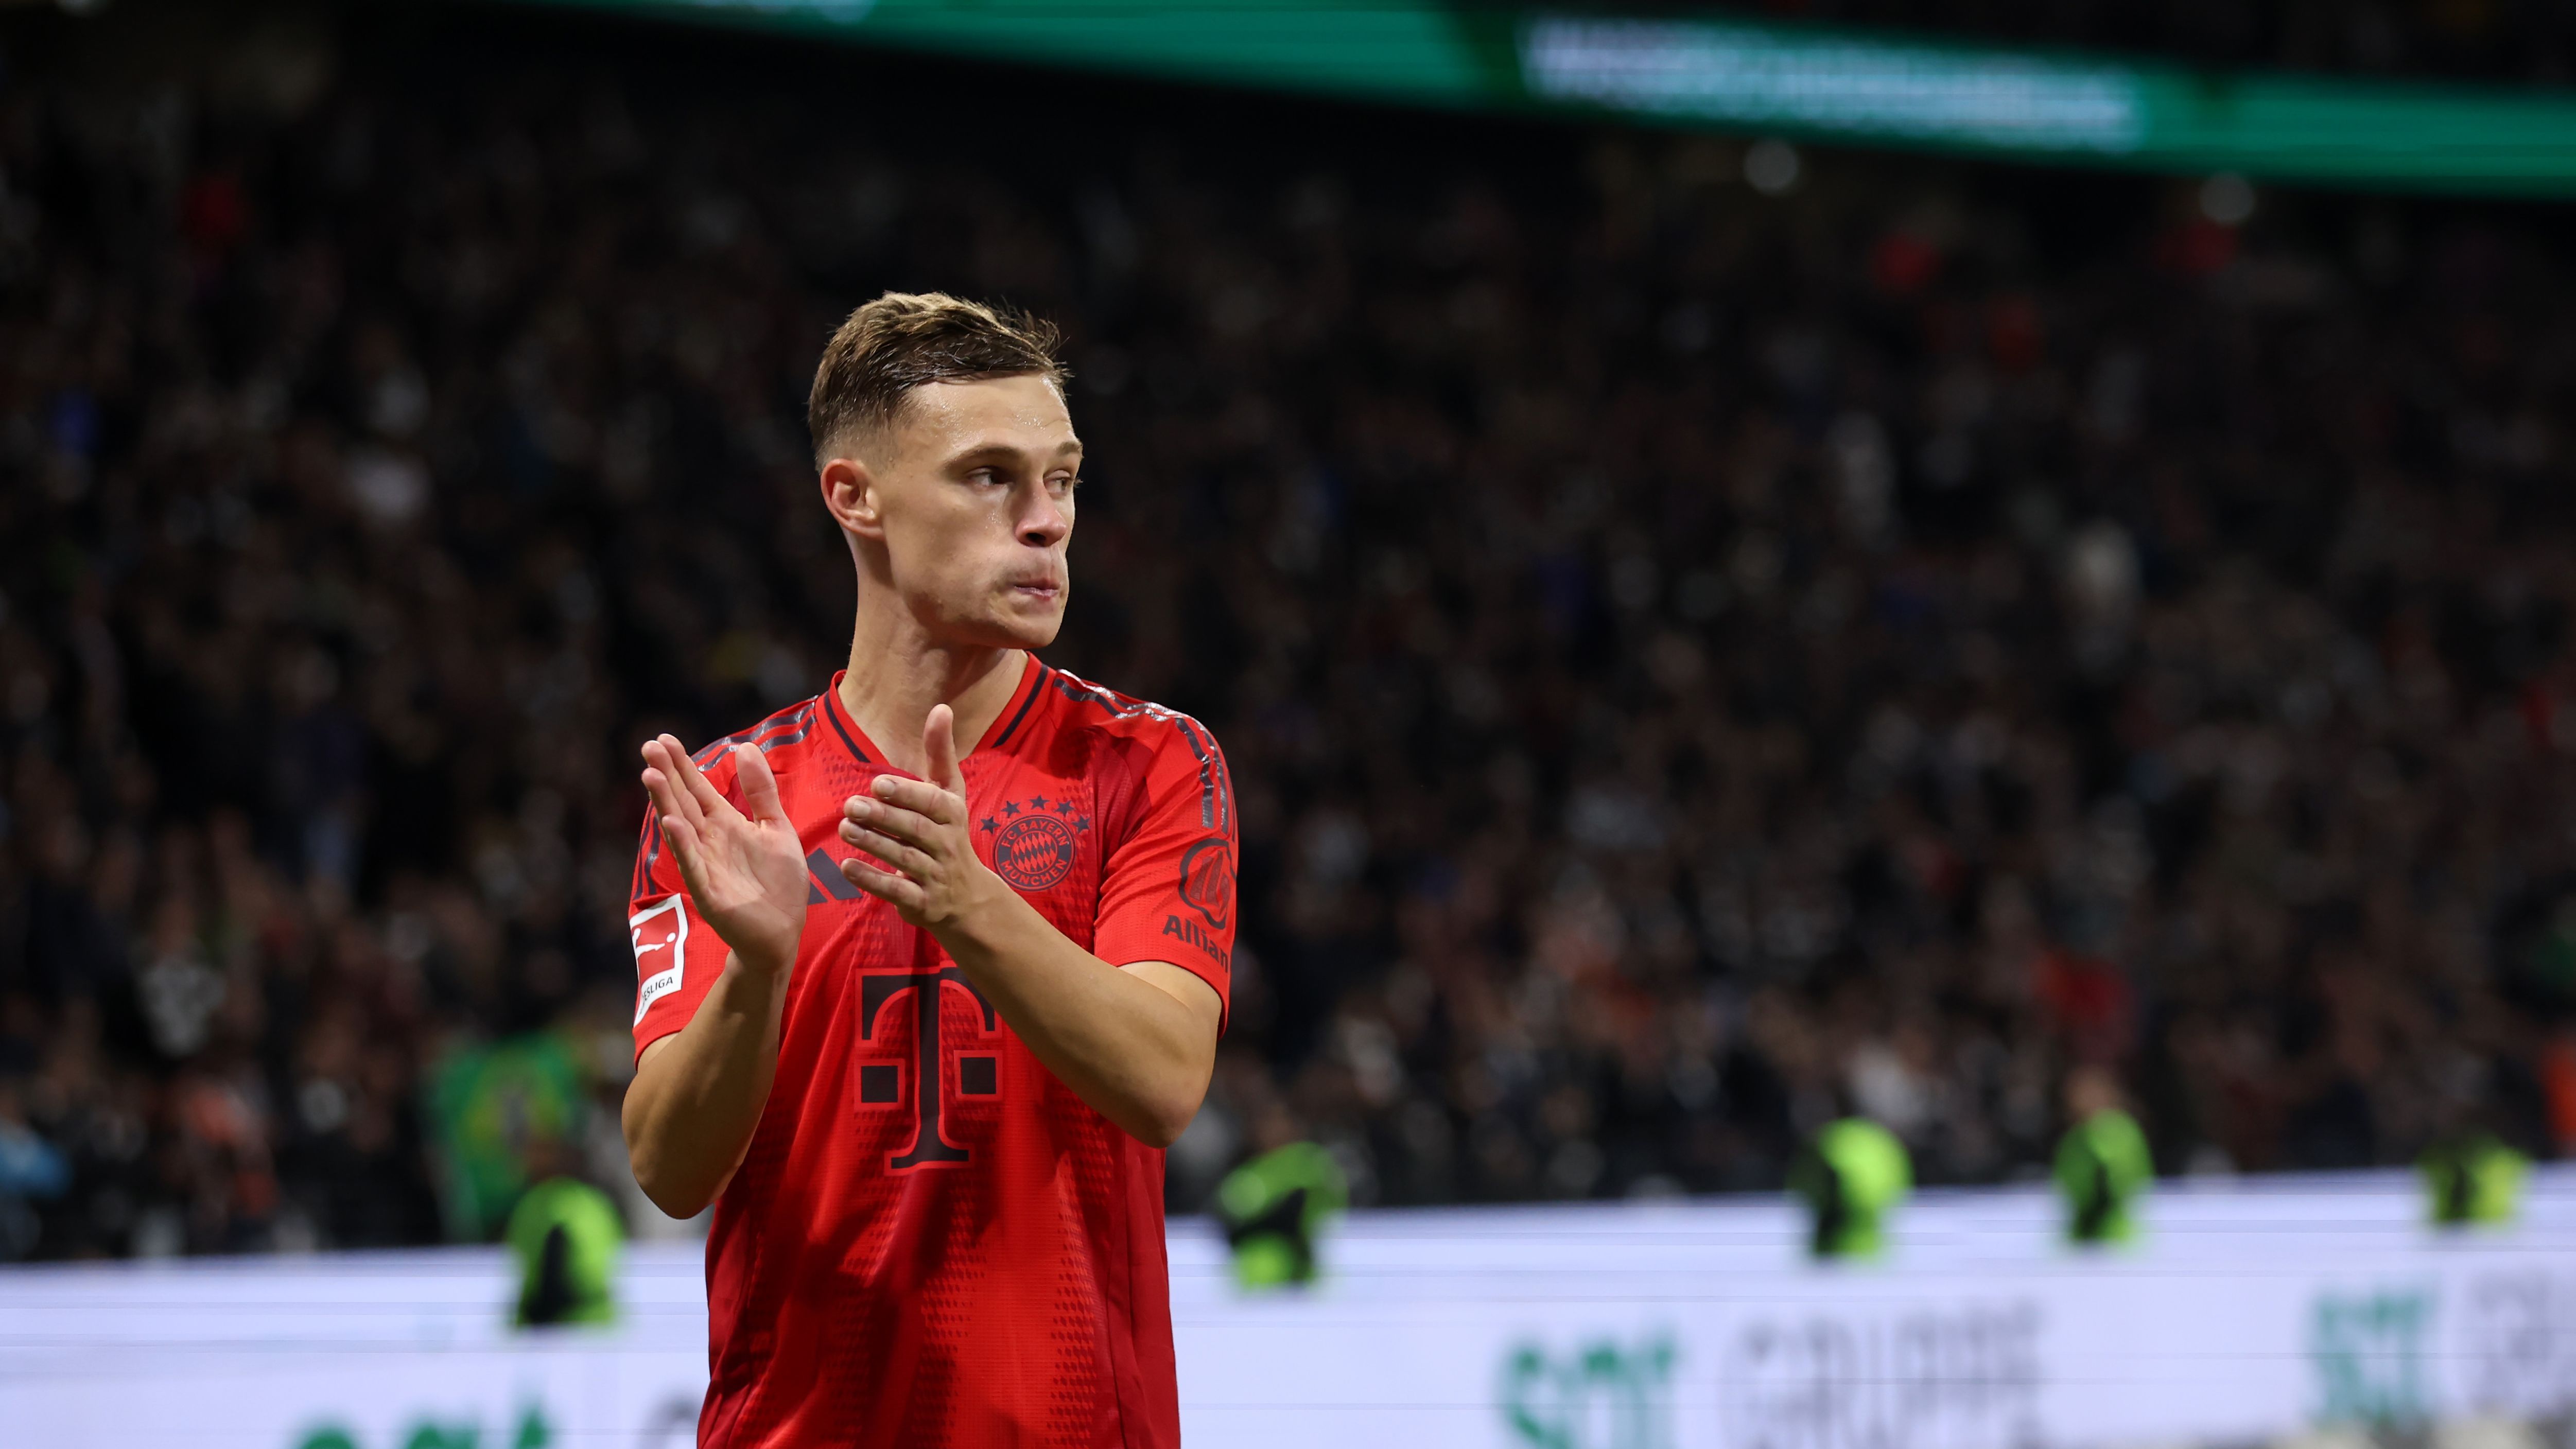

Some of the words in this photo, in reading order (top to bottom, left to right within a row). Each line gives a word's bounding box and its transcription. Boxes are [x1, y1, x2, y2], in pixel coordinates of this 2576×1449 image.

[1001, 830, 1017, 847] FC
[1018, 820, 1070, 846] BAYERN
[1162, 915, 1229, 973] Allian
[640, 976, 673, 1013] ESLIGA
